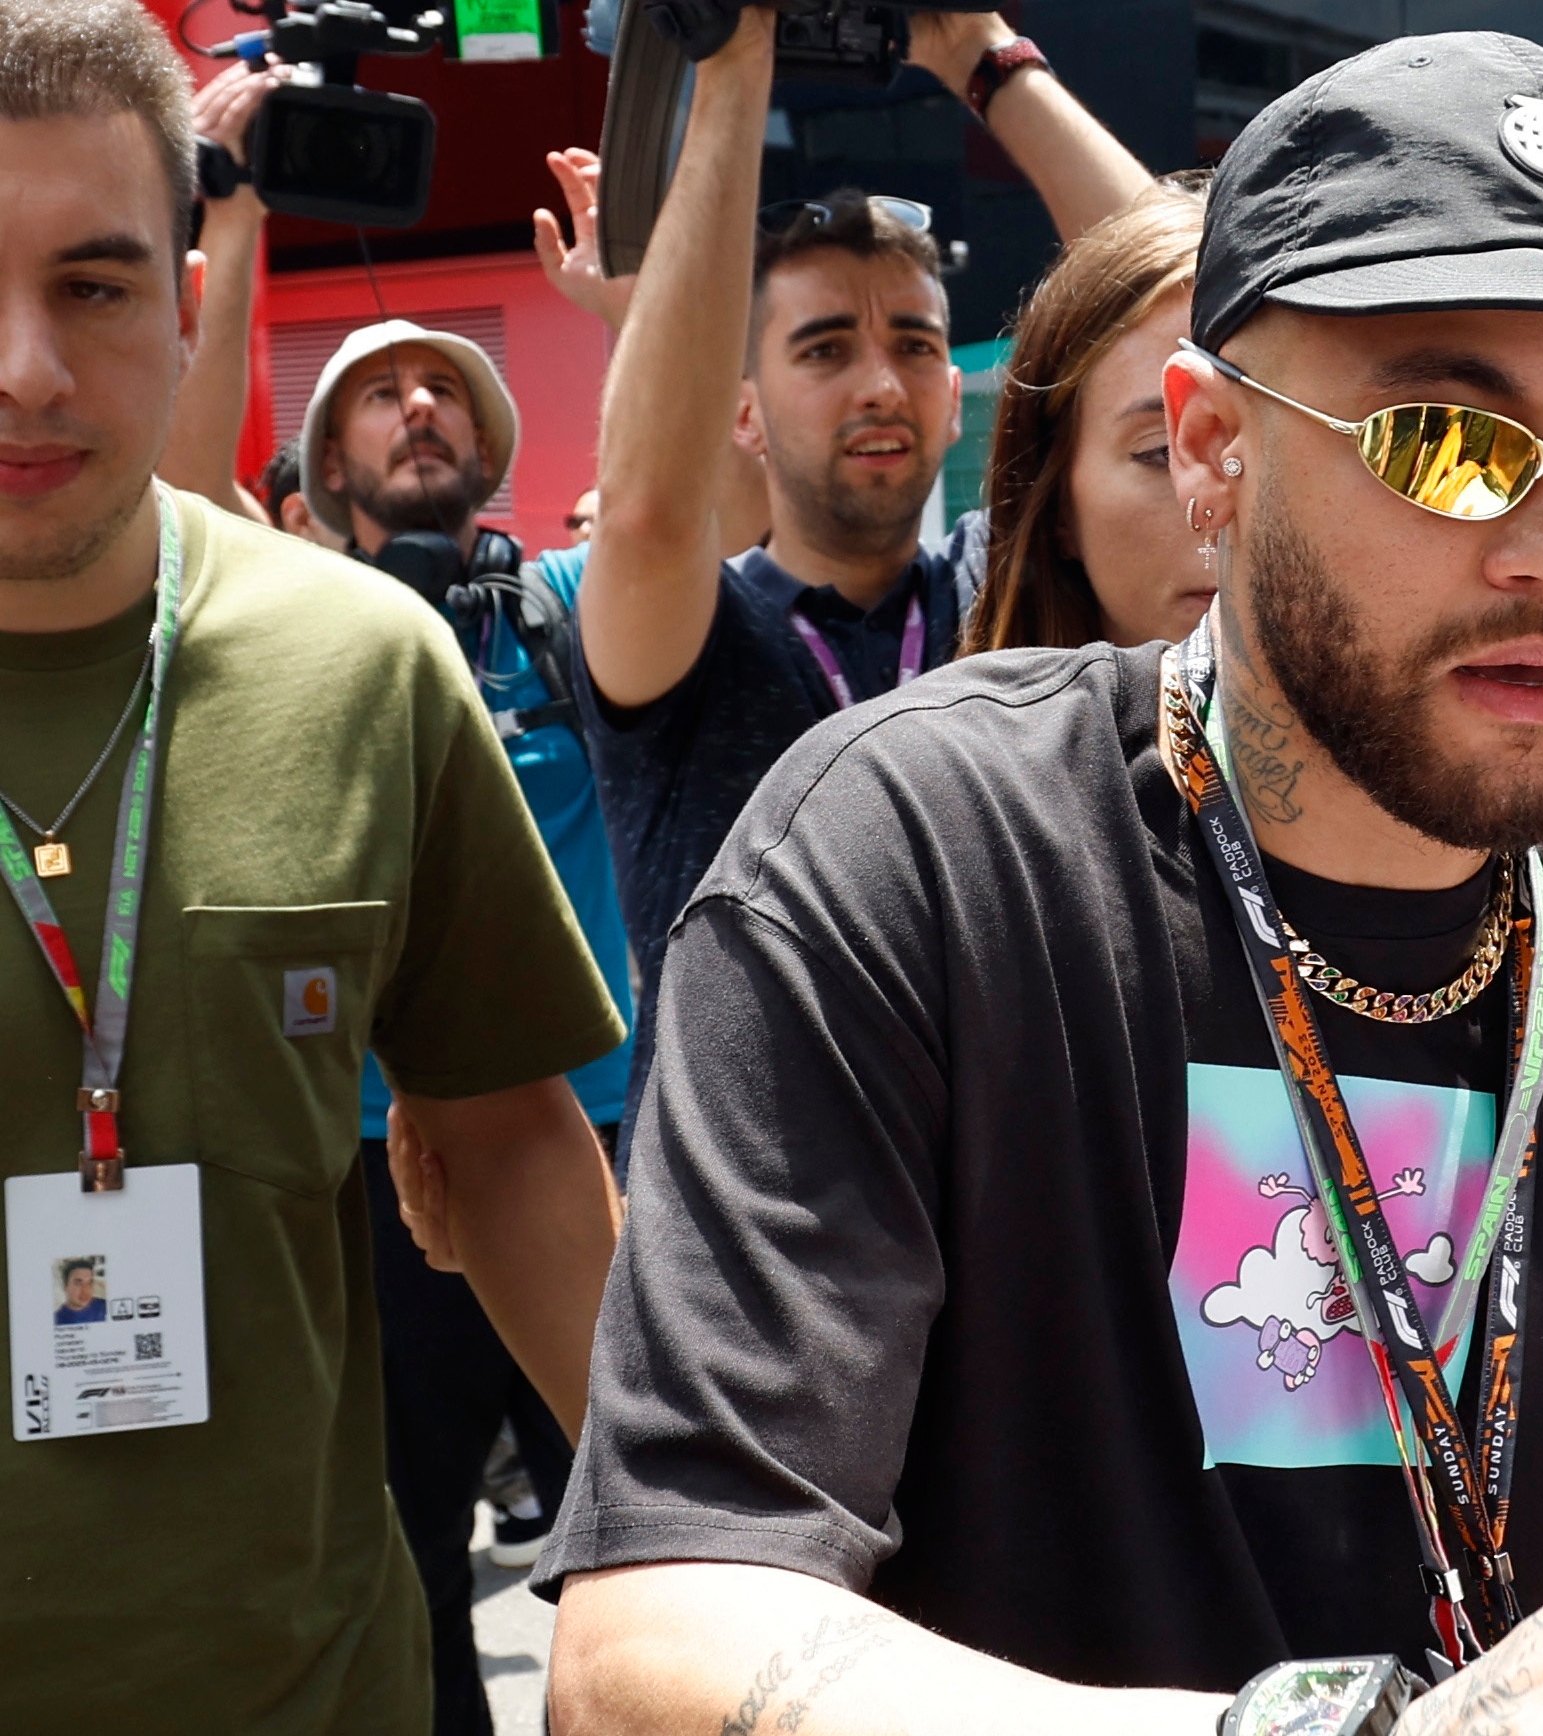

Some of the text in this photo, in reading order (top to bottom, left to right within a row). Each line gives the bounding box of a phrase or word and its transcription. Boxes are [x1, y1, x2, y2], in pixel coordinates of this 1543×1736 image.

[1209, 817, 1243, 881] PADDOCK
[1231, 841, 1251, 877] CLUB
[1237, 886, 1281, 948] F1
[1298, 1034, 1343, 1138] SPAIN 2023
[1361, 1221, 1389, 1286] PADDOCK
[1464, 1176, 1511, 1280] SPAIN
[1513, 1215, 1524, 1252] CLUB
[1379, 1244, 1397, 1281] CLUB
[1500, 1255, 1520, 1329] F1
[1382, 1289, 1423, 1350] F1
[25, 1374, 42, 1434] VIP
[1434, 1427, 1469, 1504] SUNDAY
[1488, 1408, 1507, 1495] SUNDAY
